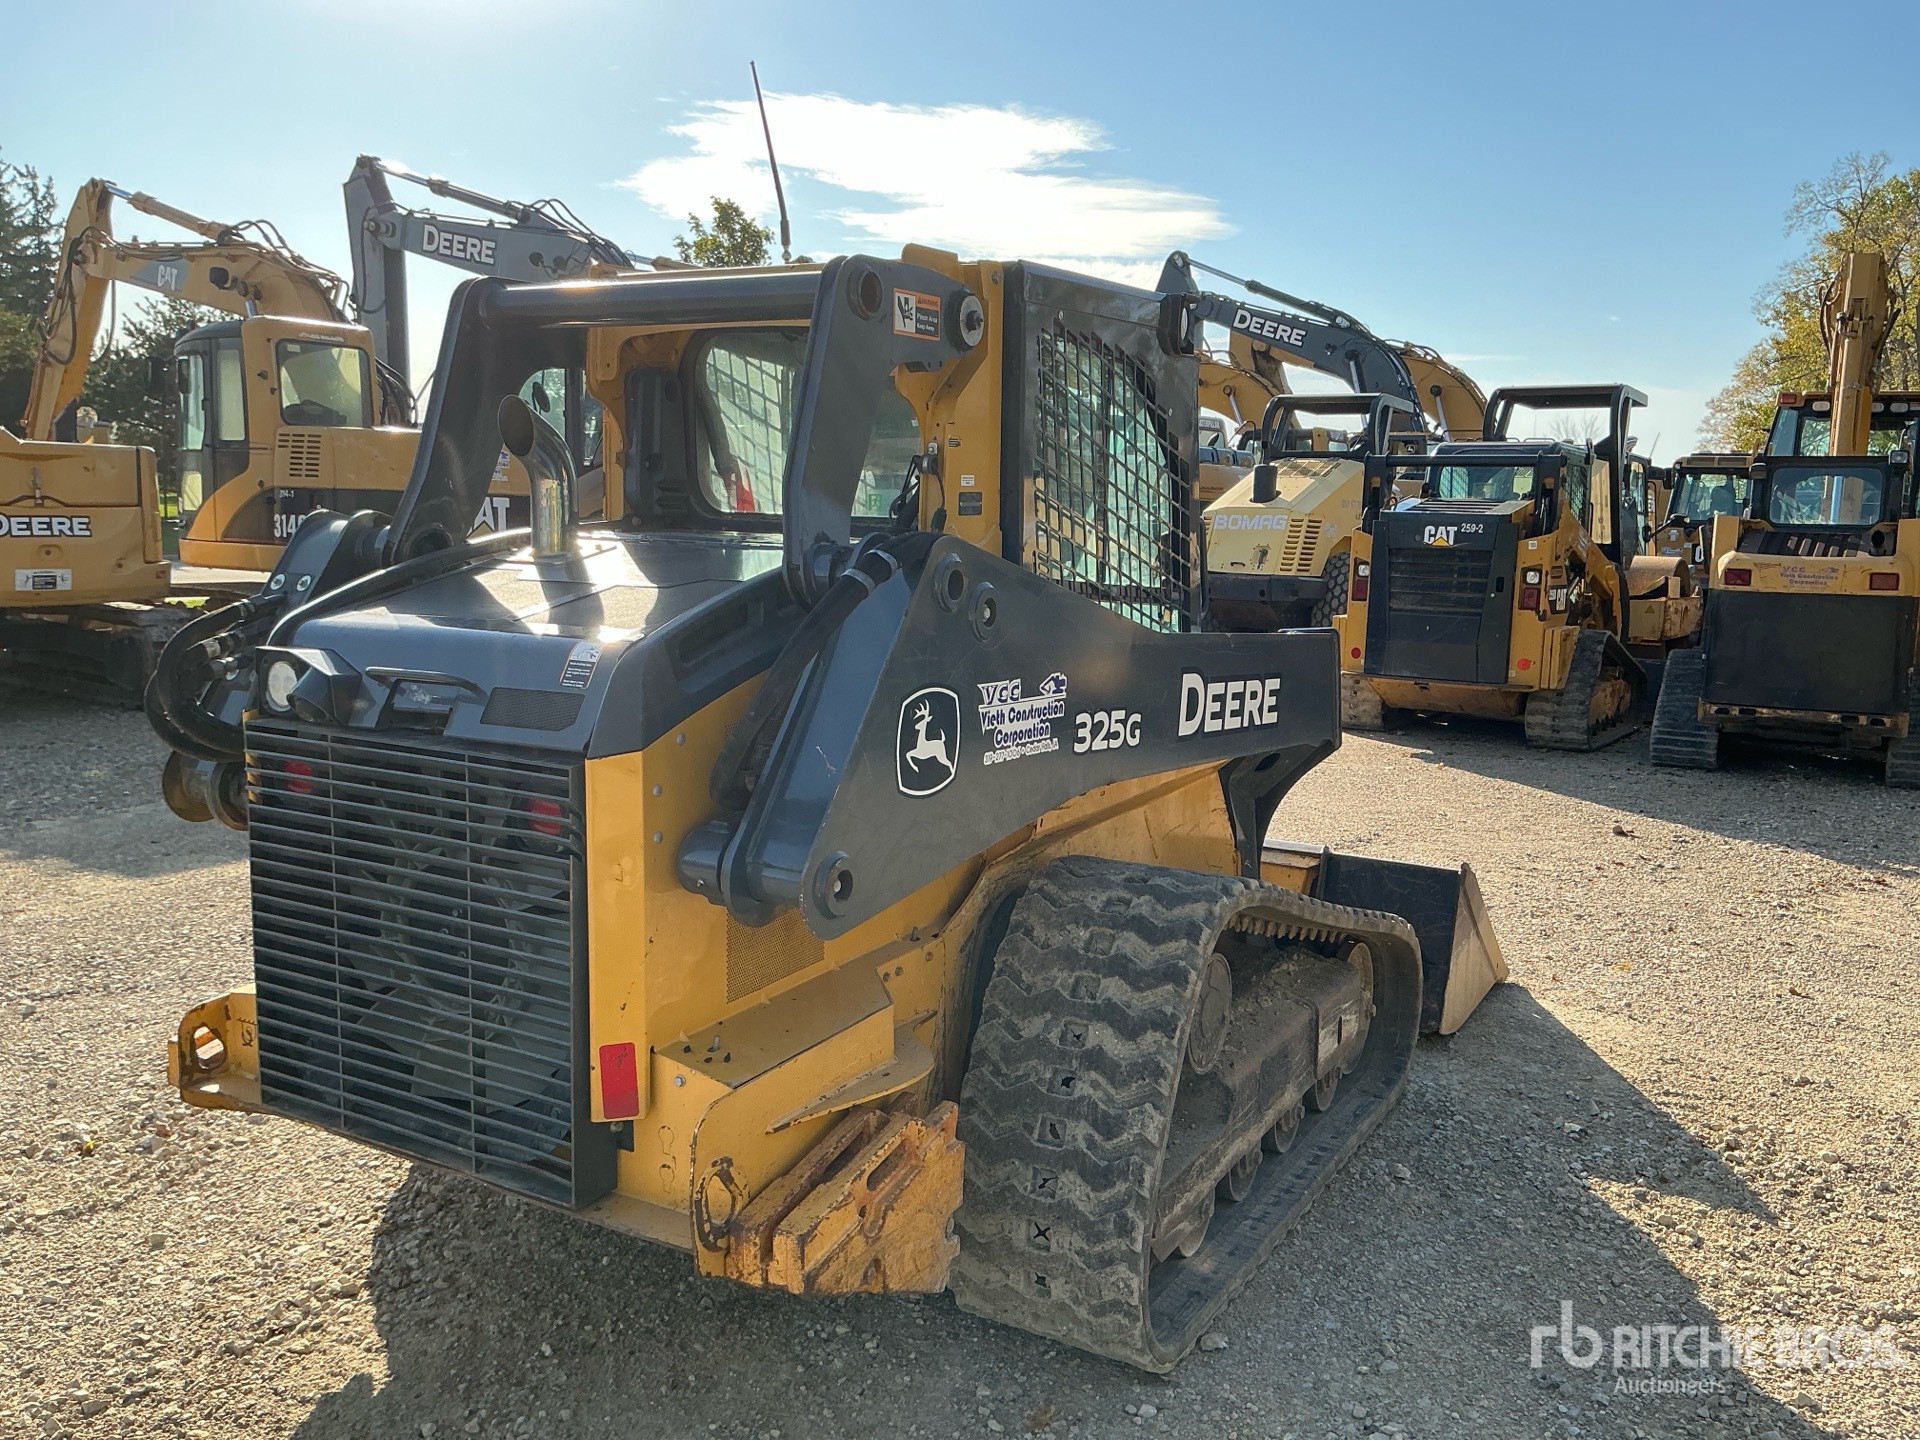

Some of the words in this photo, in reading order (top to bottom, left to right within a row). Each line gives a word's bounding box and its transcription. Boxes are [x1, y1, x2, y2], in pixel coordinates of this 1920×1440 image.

[423, 224, 496, 264] DEERE
[157, 264, 178, 291] CAT
[1233, 309, 1307, 346] DEERE
[466, 496, 510, 538] AT
[1214, 514, 1288, 530] BOMAG
[1461, 523, 1484, 534] 259-2
[1424, 525, 1457, 546] CAT
[981, 680, 1020, 705] VCC
[1178, 673, 1281, 737] DEERE
[981, 709, 1005, 727] Vieth
[1008, 700, 1064, 723] Construction
[995, 722, 1050, 747] Corporation
[1073, 710, 1142, 753] 325G
